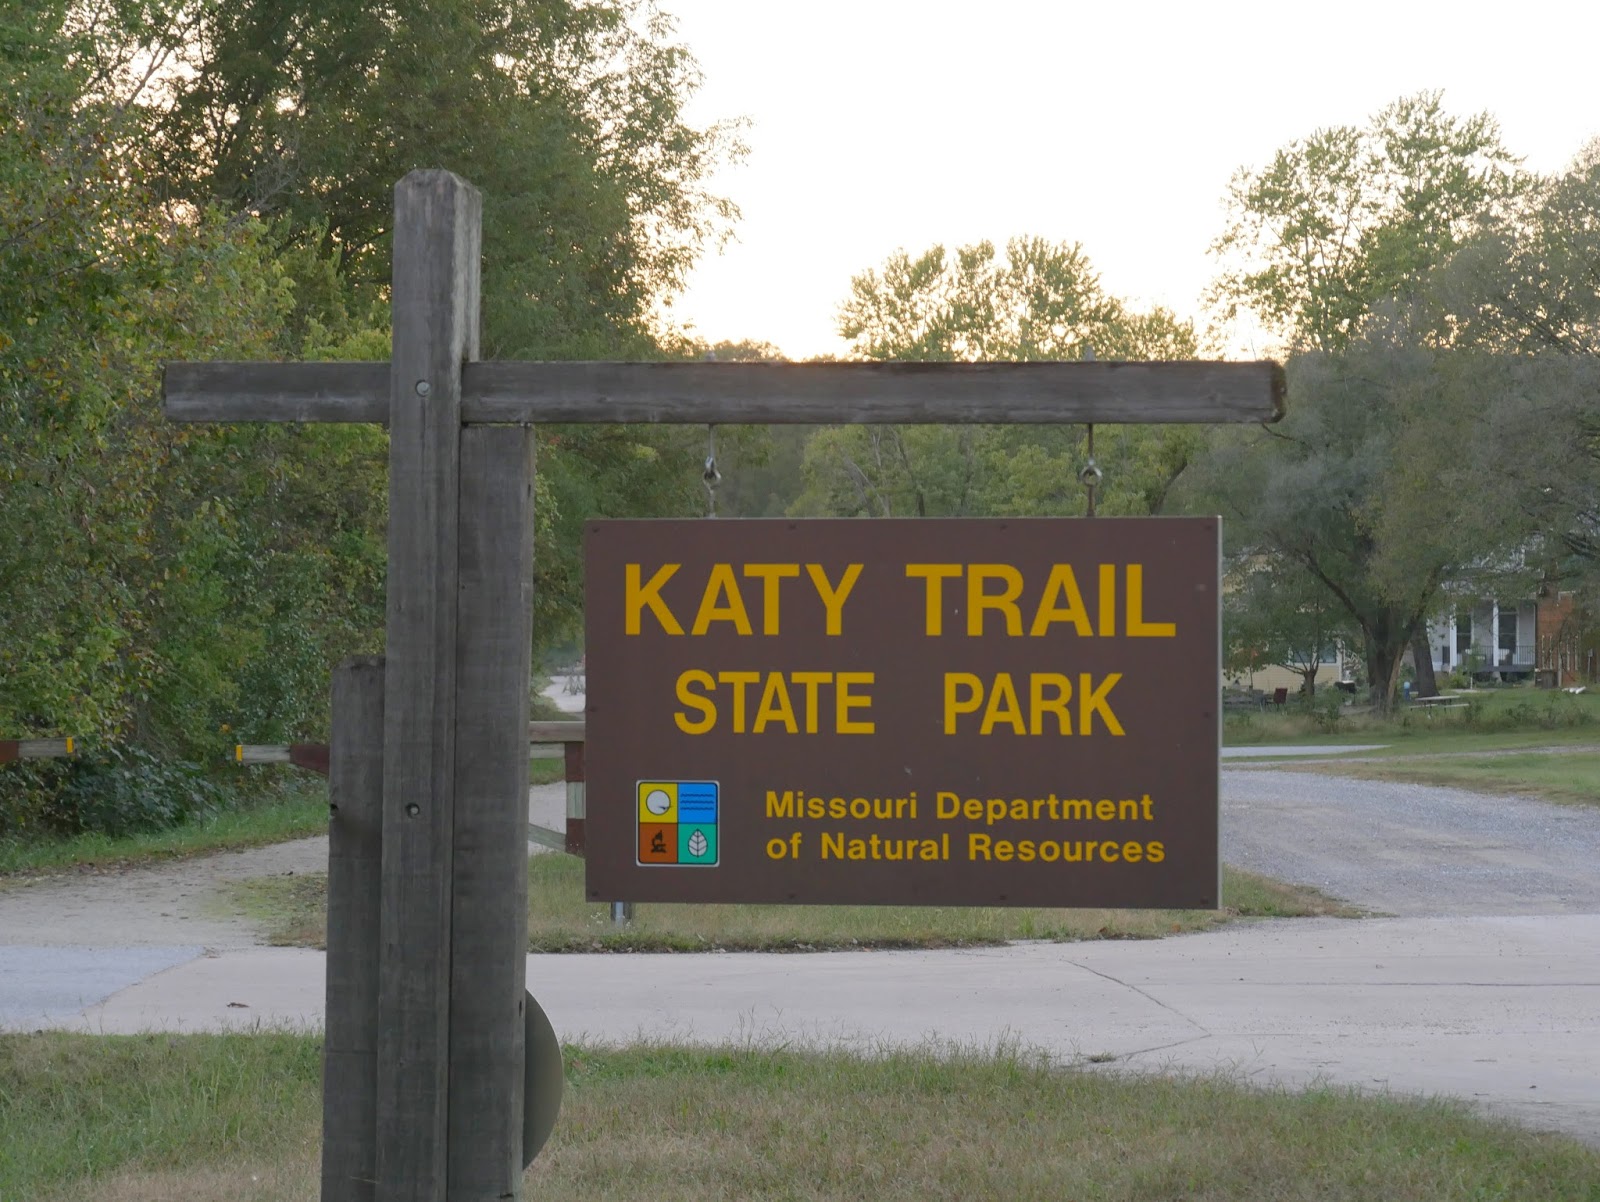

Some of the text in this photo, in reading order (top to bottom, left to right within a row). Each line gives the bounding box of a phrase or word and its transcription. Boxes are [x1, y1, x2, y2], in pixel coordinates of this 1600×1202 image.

[624, 562, 1177, 638] KATY TRAIL
[673, 668, 1126, 737] STATE PARK
[765, 789, 1154, 826] Missouri Department
[765, 831, 1166, 864] of Natural Resources
